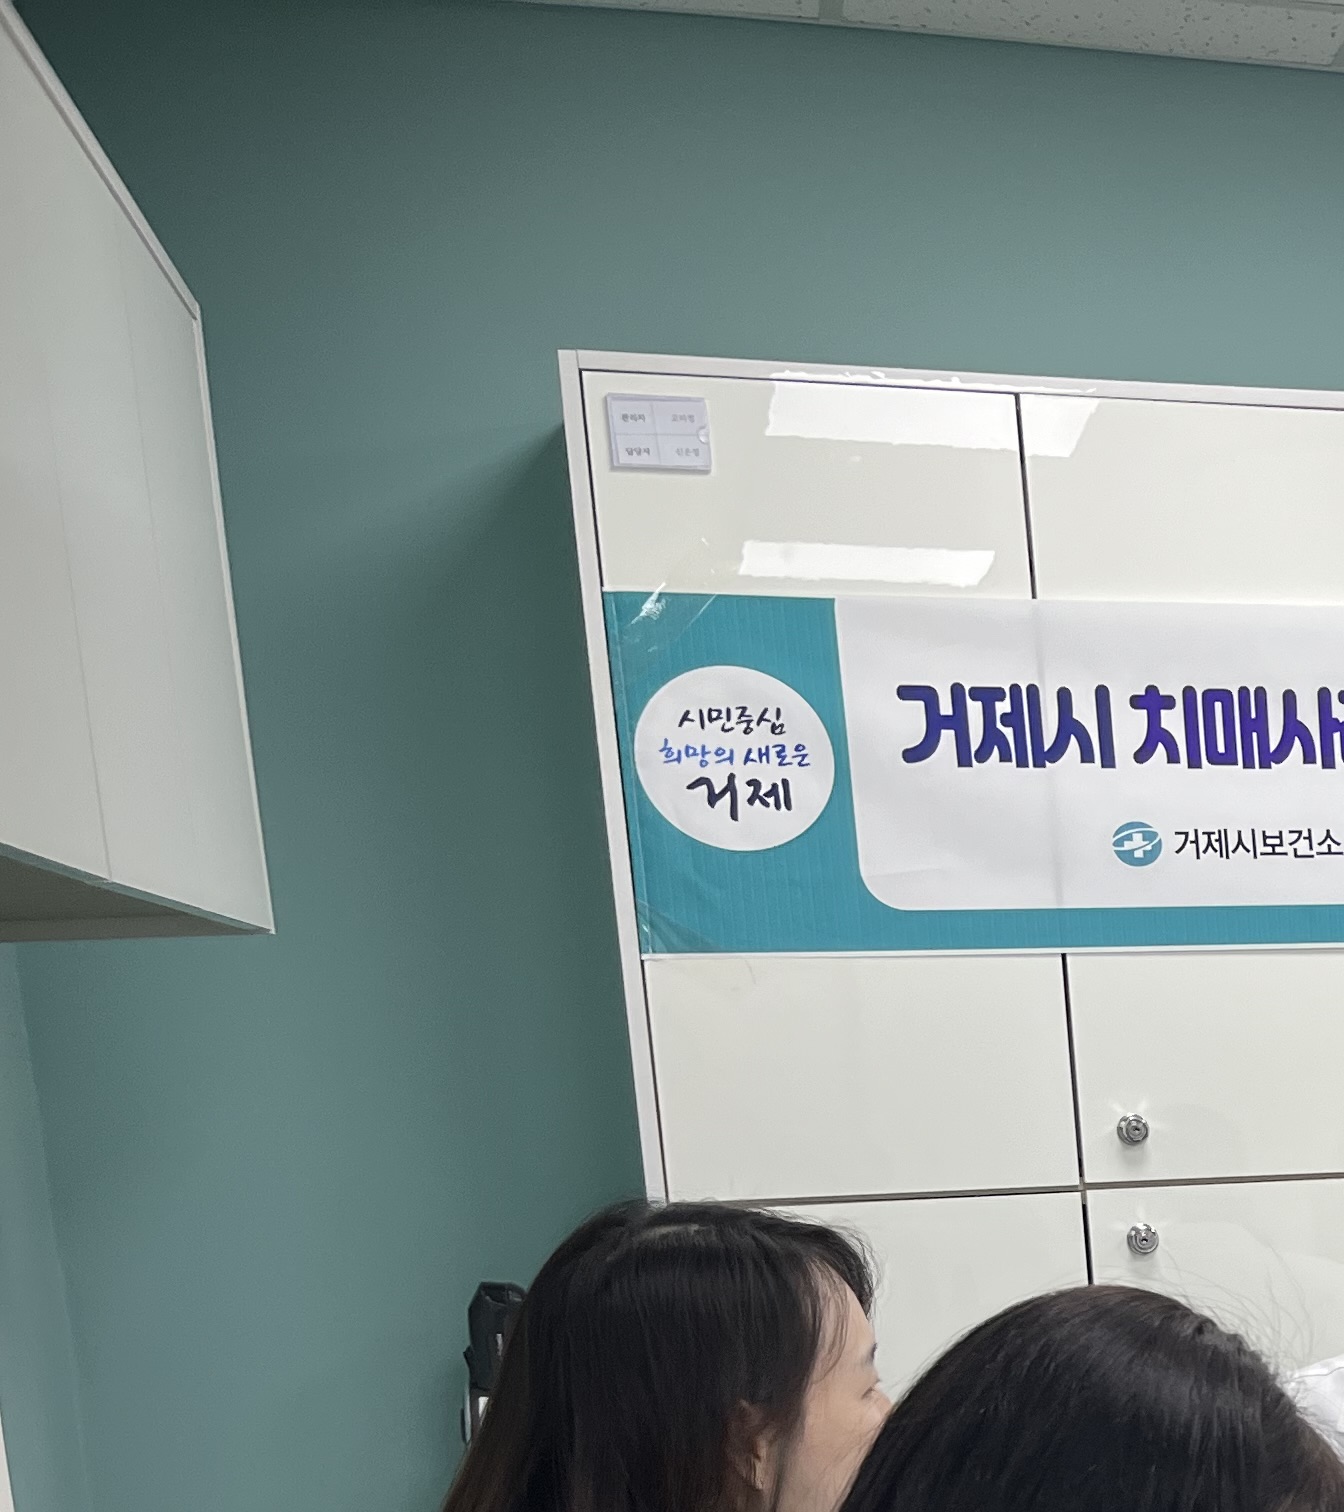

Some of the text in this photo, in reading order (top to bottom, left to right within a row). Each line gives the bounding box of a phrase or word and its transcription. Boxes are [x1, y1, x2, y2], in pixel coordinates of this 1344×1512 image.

[677, 705, 788, 737] 시민중심
[895, 681, 1117, 770] 거제시
[657, 741, 813, 770] 희망의 새로운
[686, 773, 793, 822] 거제
